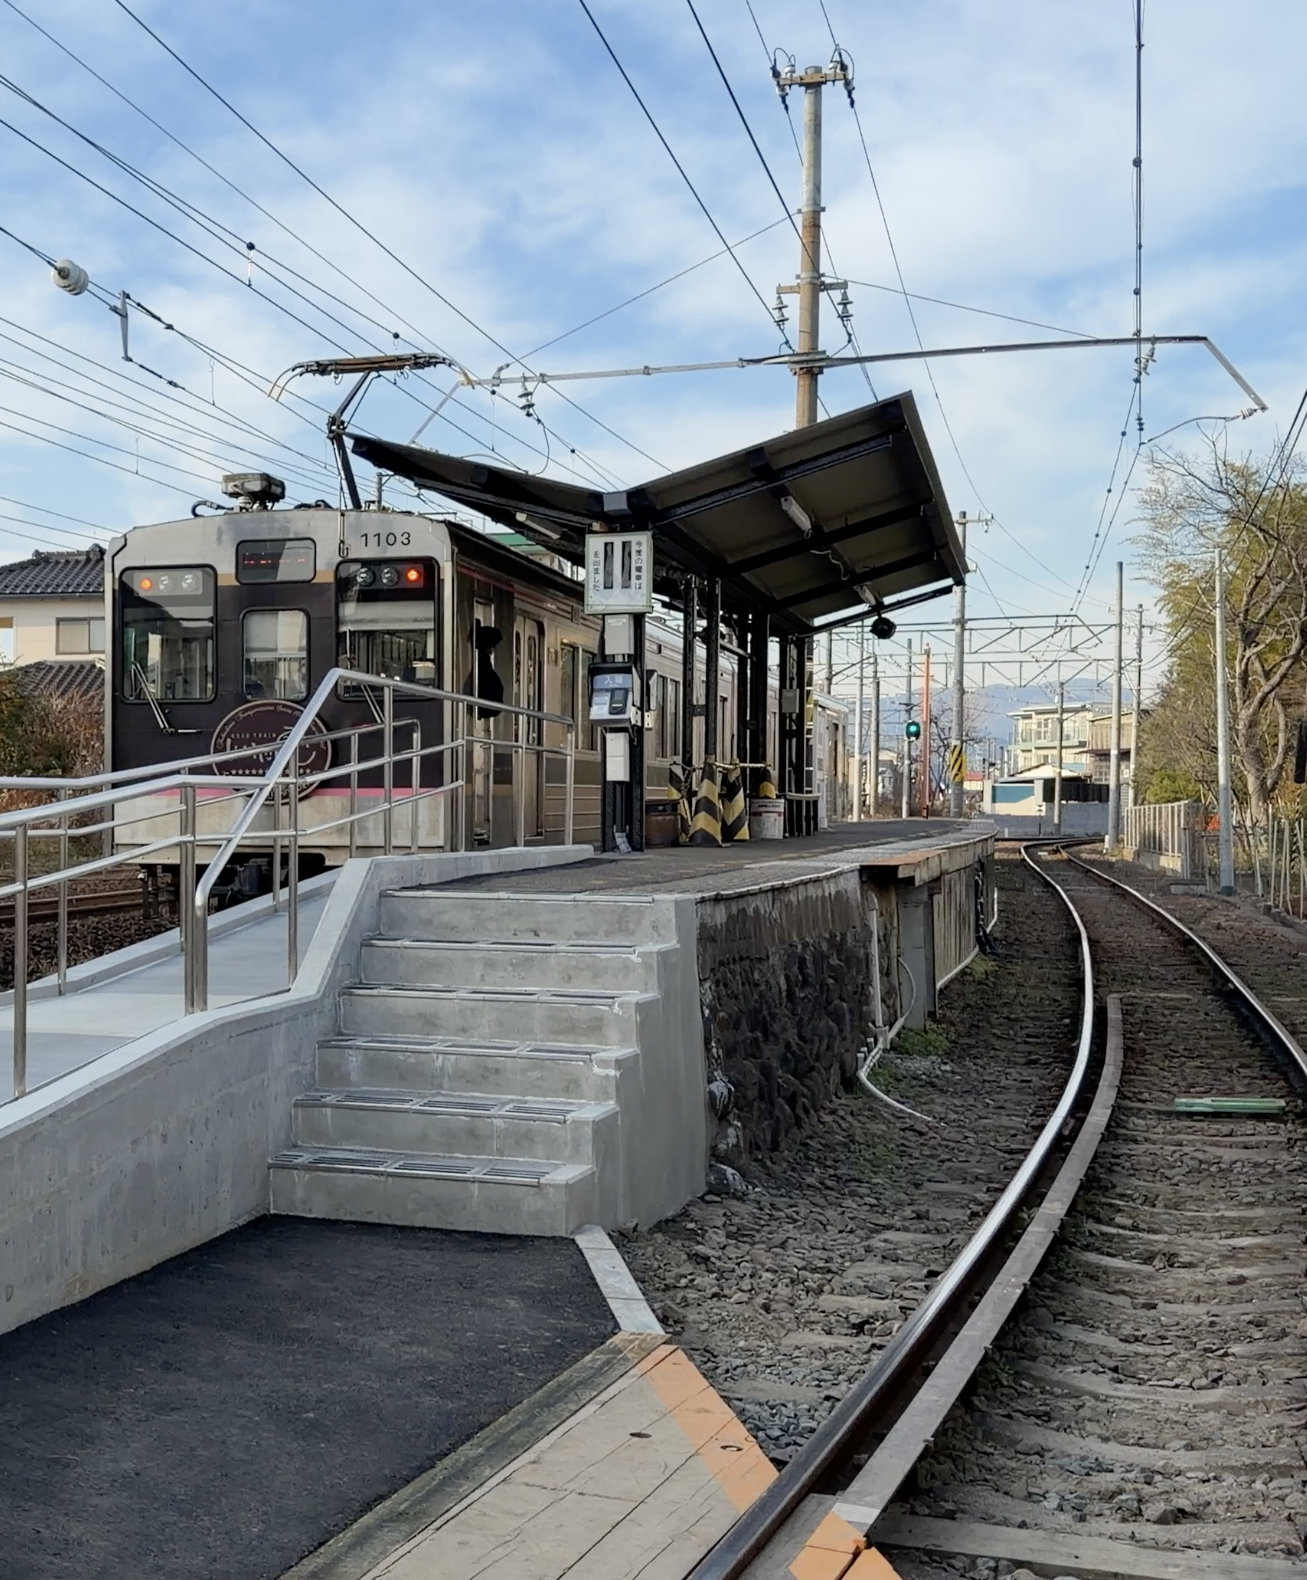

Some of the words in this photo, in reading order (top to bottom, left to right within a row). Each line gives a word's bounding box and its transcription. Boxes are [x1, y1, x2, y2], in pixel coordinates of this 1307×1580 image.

[360, 531, 411, 547] 1103
[593, 550, 601, 592] を出ました
